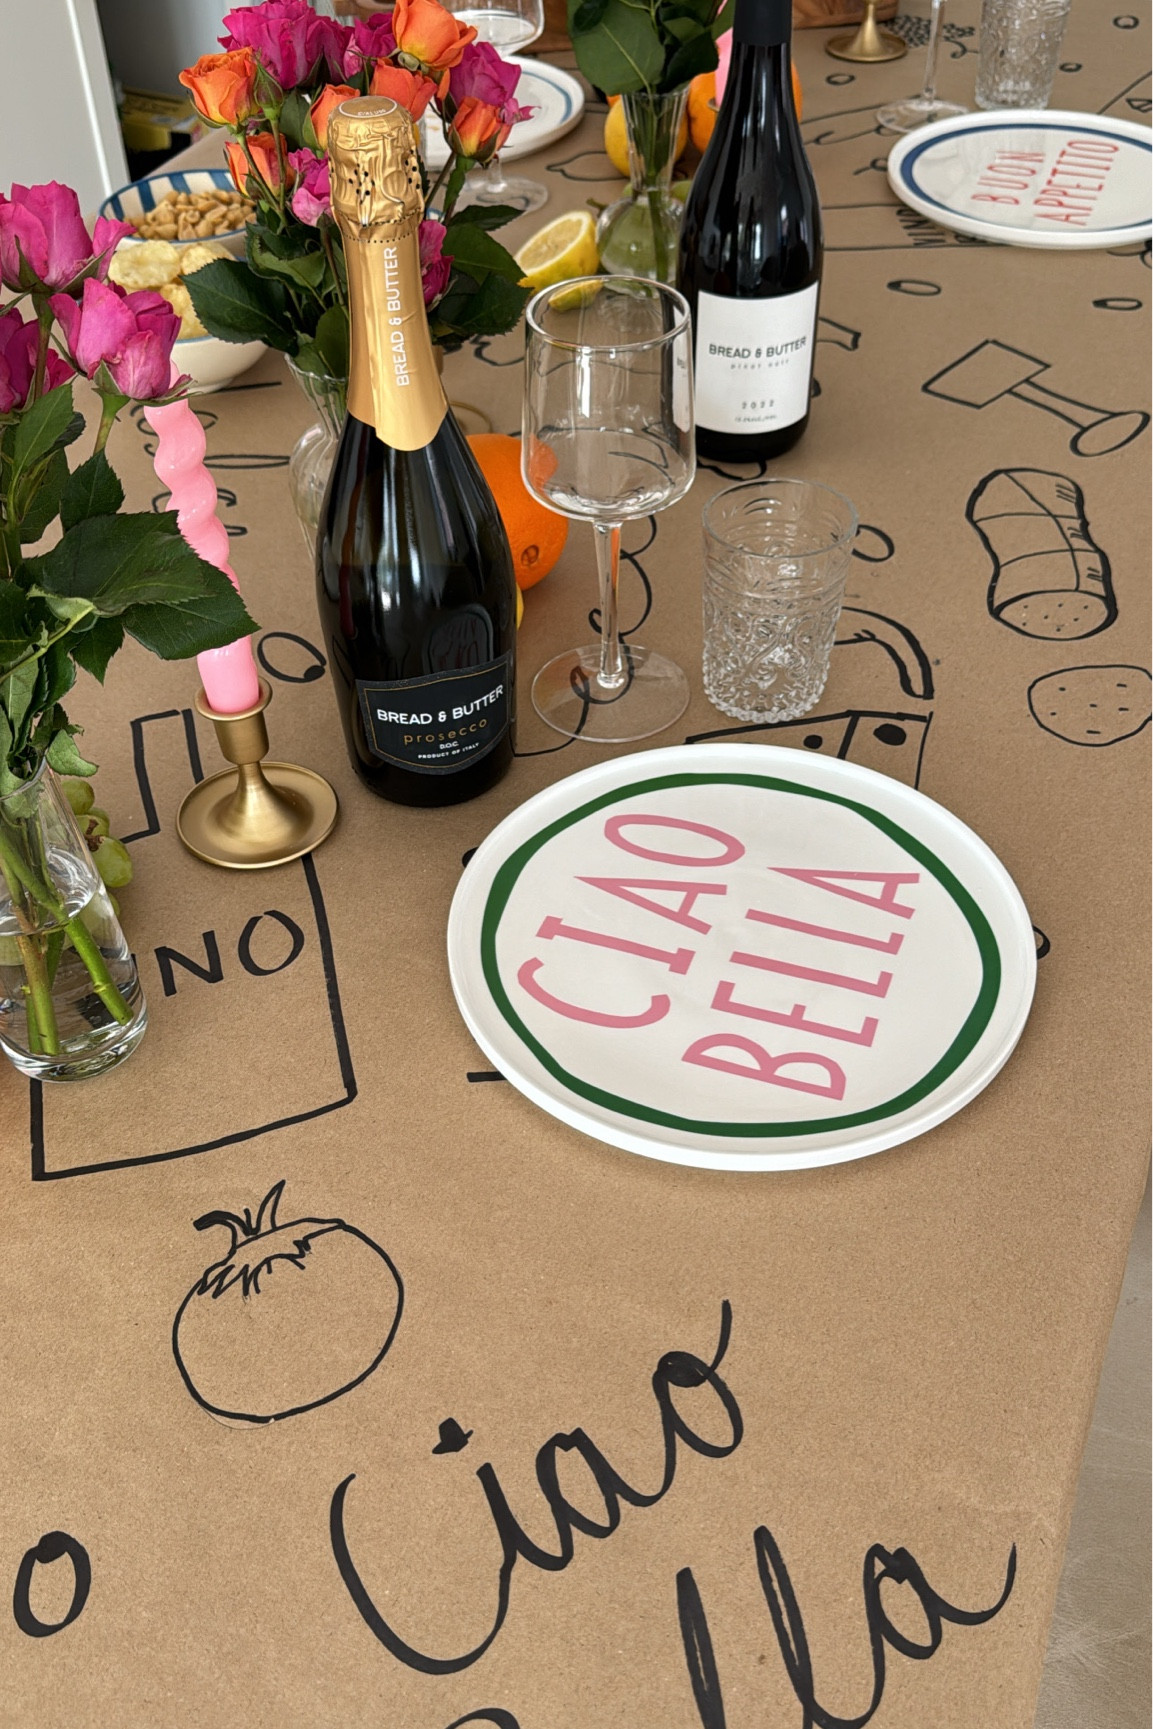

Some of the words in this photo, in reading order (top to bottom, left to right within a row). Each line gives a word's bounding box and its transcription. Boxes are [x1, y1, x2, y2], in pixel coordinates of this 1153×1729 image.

[971, 150, 1046, 205] BUON
[1033, 140, 1119, 227] APPETITO
[383, 246, 401, 312] BUTTER
[388, 317, 402, 326] &
[708, 343, 751, 359] BREAD
[754, 347, 762, 358] &
[765, 336, 807, 357] BUTTER
[390, 331, 410, 387] BREAD
[376, 708, 433, 725] BREAD
[438, 710, 448, 723] &
[452, 684, 504, 720] BUTTER
[403, 718, 488, 746] prosecco
[417, 752, 450, 760] PRODUCT
[462, 742, 480, 752] ITALY
[517, 813, 746, 1029] CIAO
[681, 867, 921, 1101] BELLA
[330, 1299, 745, 1676] Ciao
[445, 1525, 1018, 1729] lla
